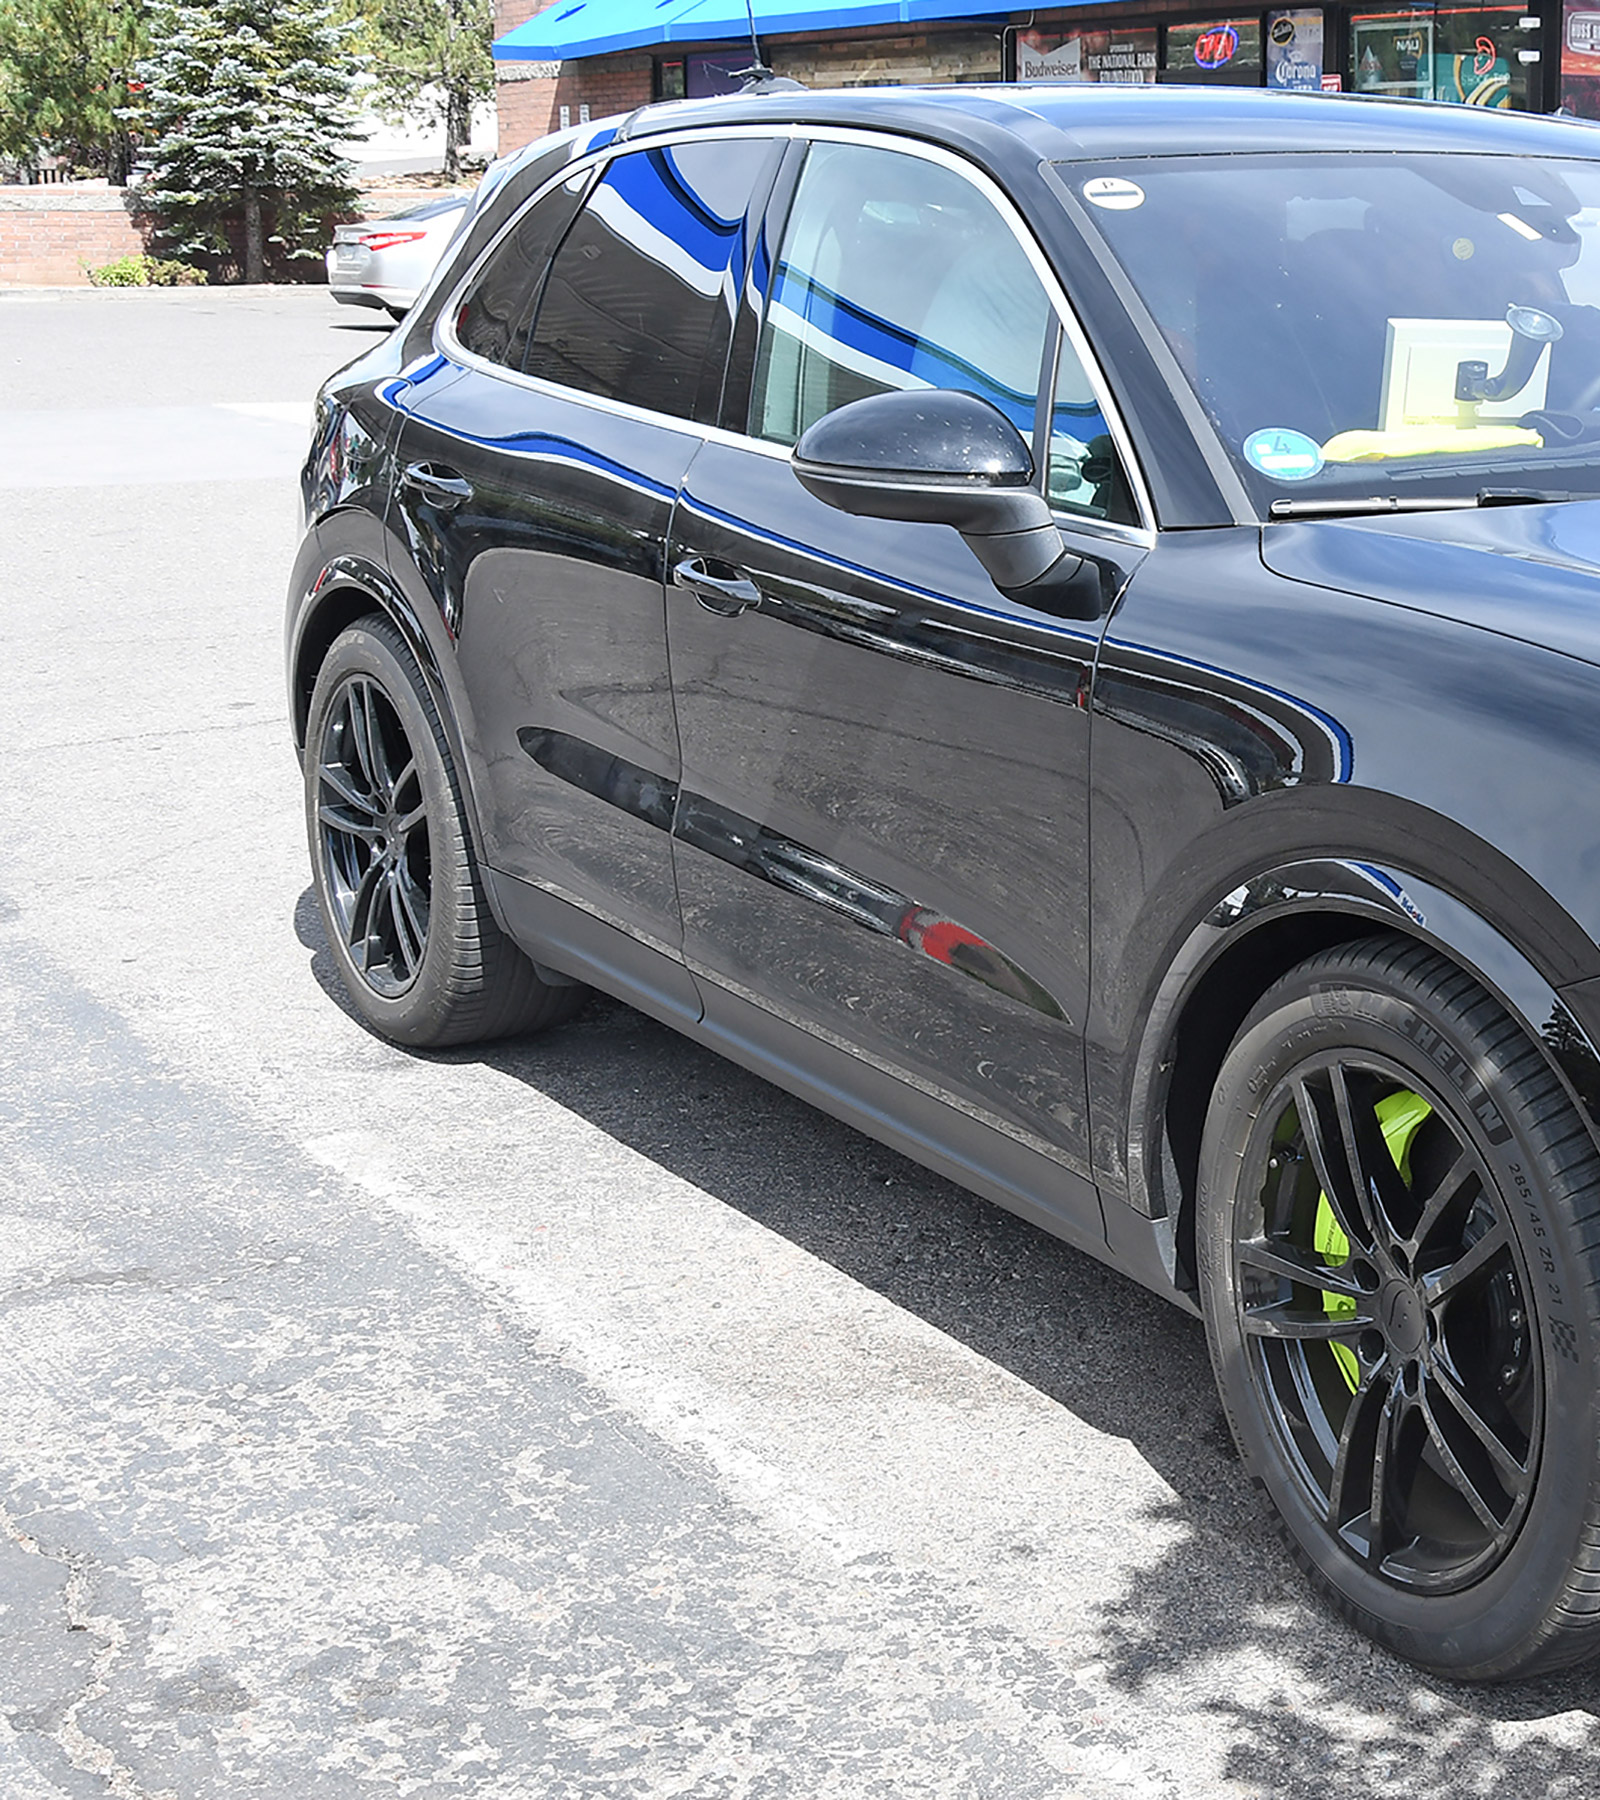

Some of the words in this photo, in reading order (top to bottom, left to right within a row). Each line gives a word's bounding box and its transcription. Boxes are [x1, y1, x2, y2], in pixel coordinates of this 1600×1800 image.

[1195, 33, 1234, 60] OPEN
[1025, 60, 1078, 78] Budweiser
[1088, 55, 1101, 69] THE
[1102, 54, 1136, 68] NATIONAL
[1137, 52, 1156, 67] PARK
[1100, 69, 1143, 83] FOUNDATION
[1275, 60, 1316, 86] Corona
[1273, 435, 1291, 455] 4
[1358, 990, 1503, 1132] MICHELIN
[1509, 1162, 1546, 1238] 285/45
[1538, 1245, 1556, 1274] ZR
[1548, 1281, 1562, 1305] 21
